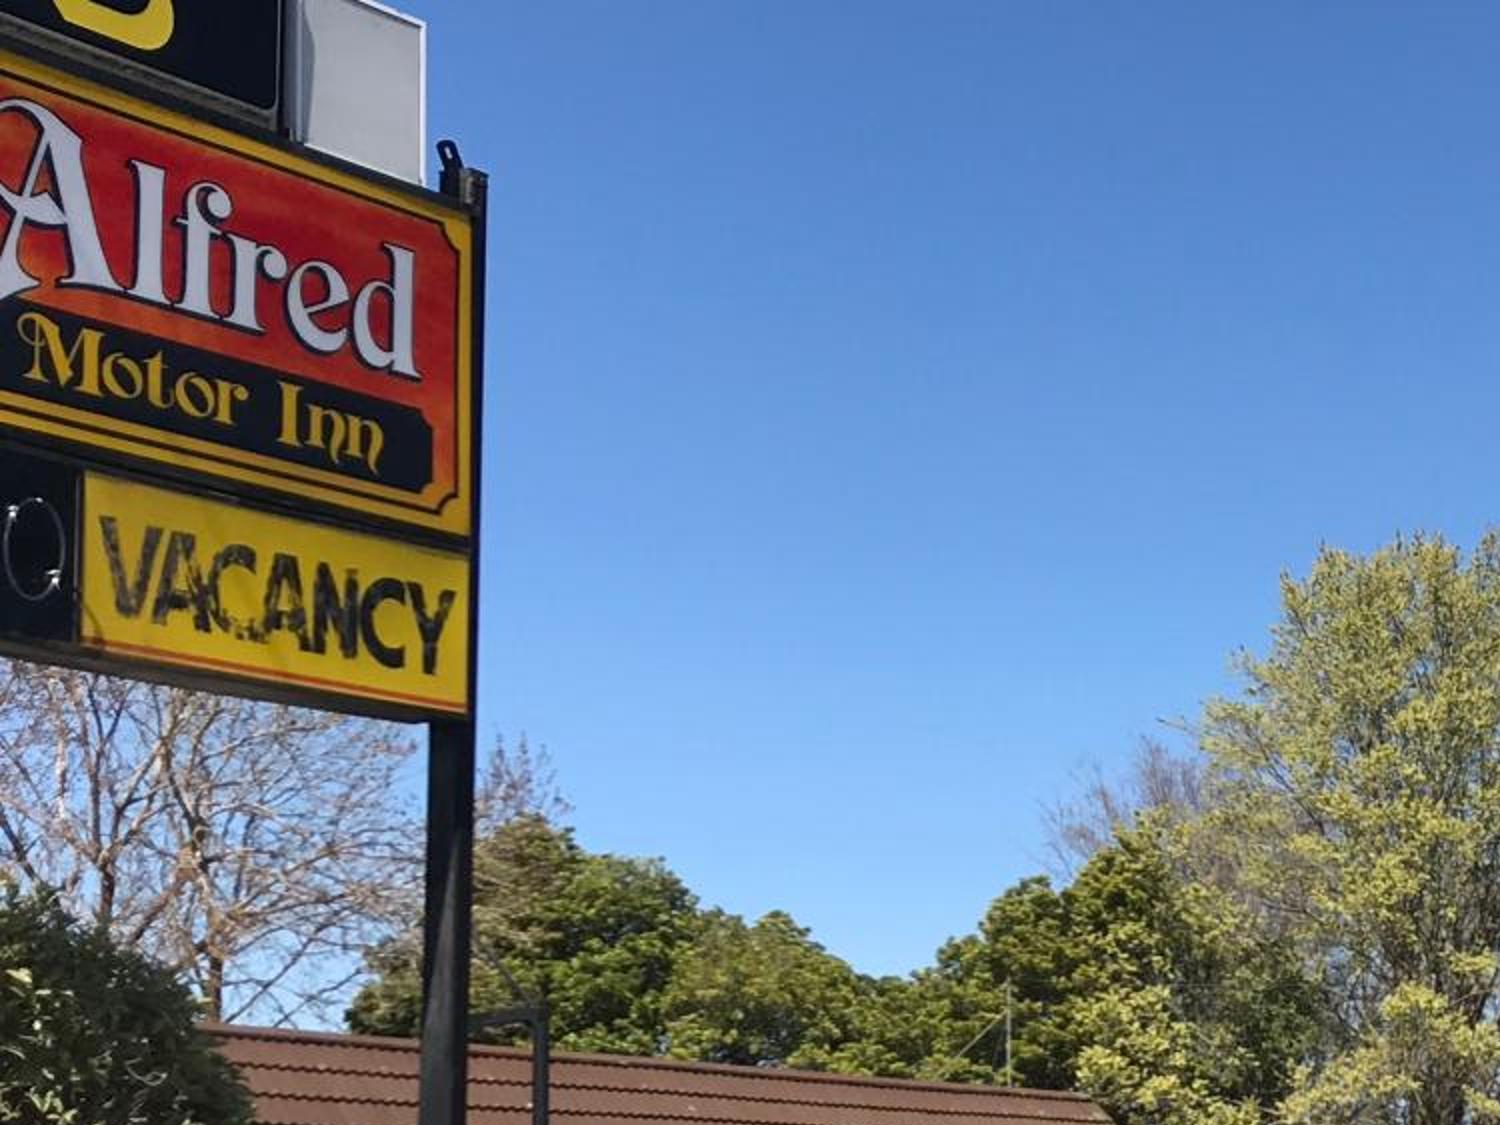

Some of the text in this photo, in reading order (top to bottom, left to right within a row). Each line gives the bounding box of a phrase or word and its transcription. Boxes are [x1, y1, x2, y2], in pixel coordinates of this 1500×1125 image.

[0, 98, 423, 382] Alfred
[16, 311, 385, 474] Motor Inn
[99, 515, 457, 676] VACANCY
